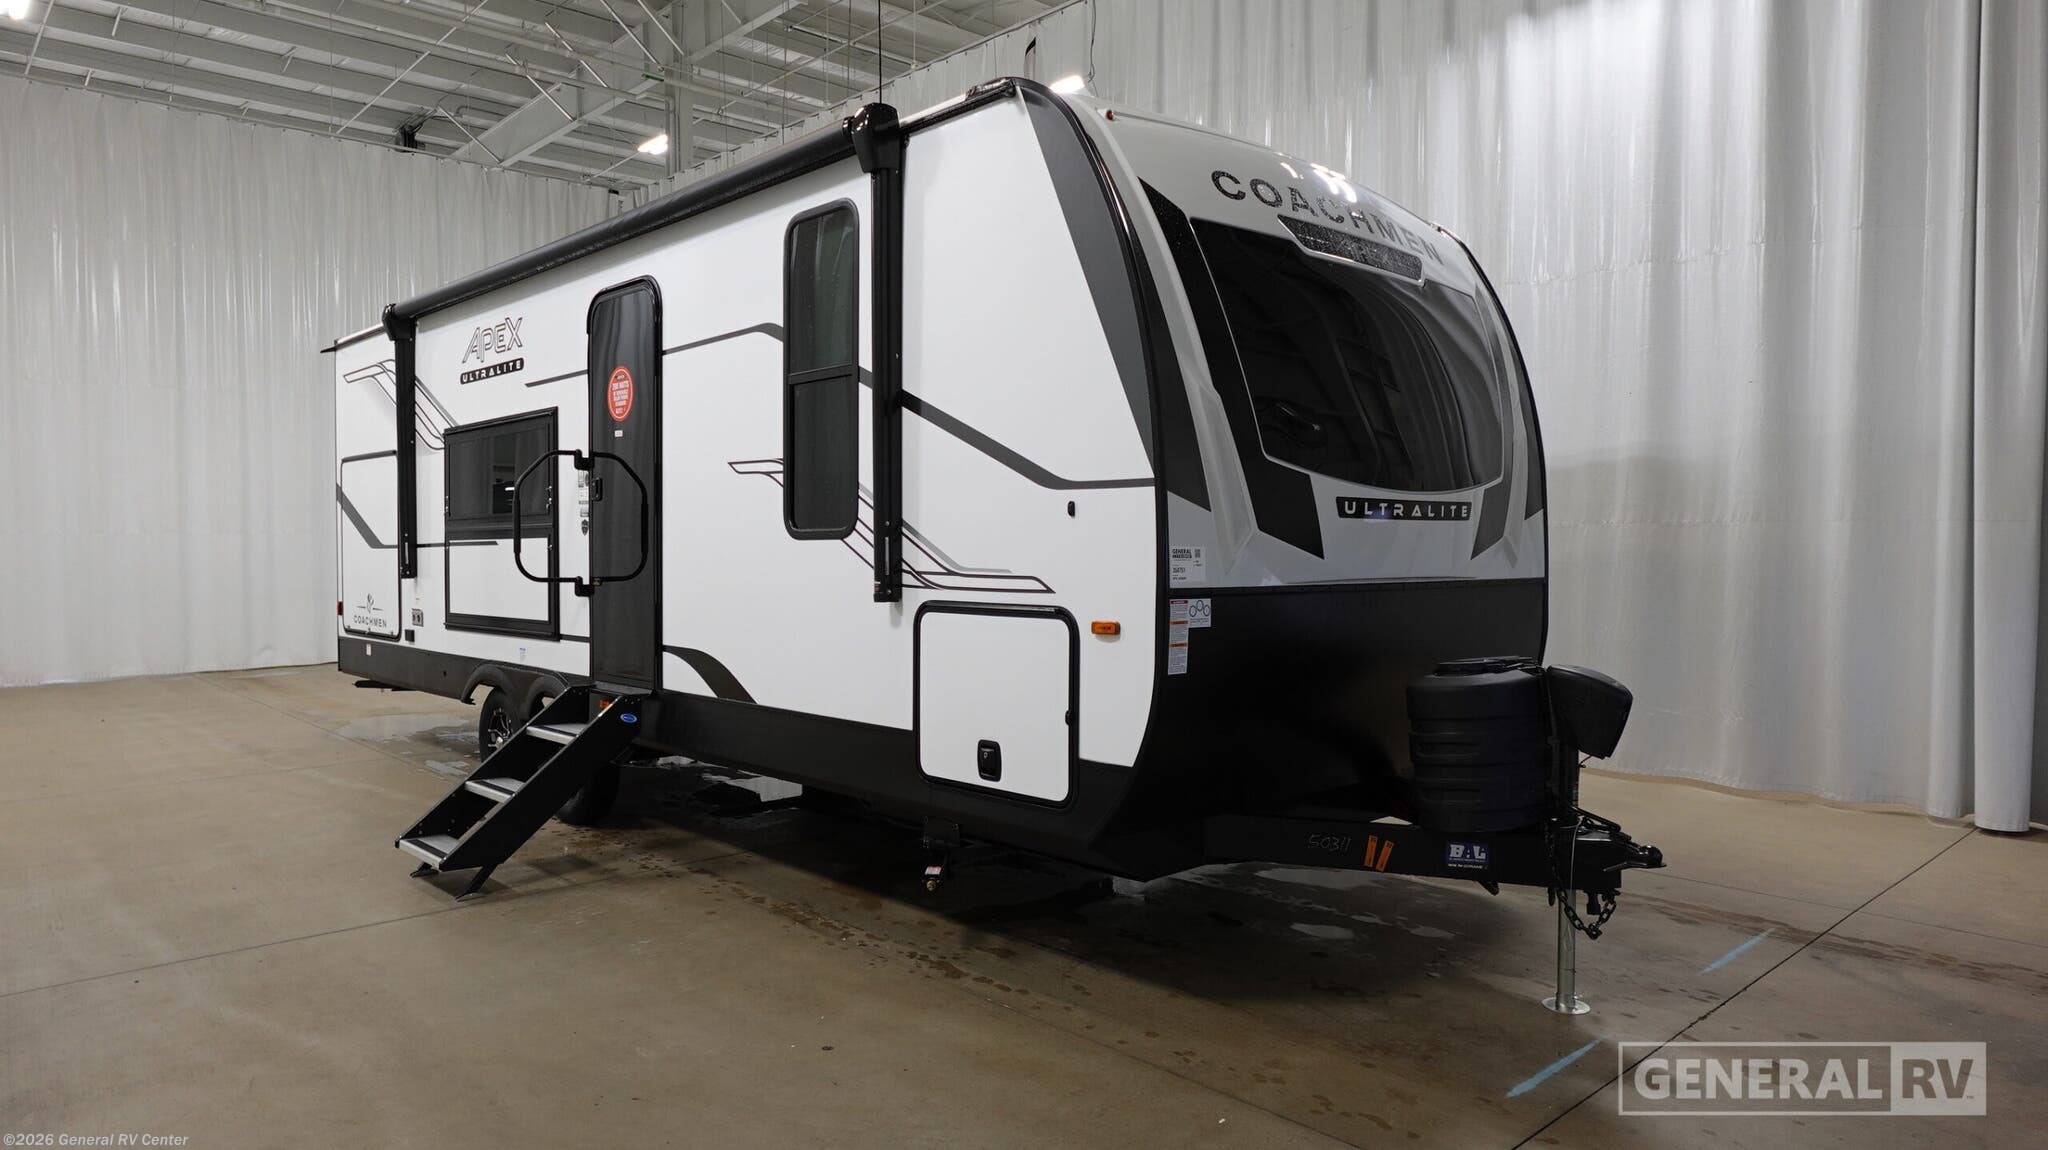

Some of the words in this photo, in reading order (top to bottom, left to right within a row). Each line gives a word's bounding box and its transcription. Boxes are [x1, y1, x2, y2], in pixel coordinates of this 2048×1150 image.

[1210, 170, 1444, 266] COACHMEN
[462, 360, 522, 383] ULTRALITE
[1344, 500, 1468, 518] ULTRALITE
[353, 614, 387, 628] COACHMEN
